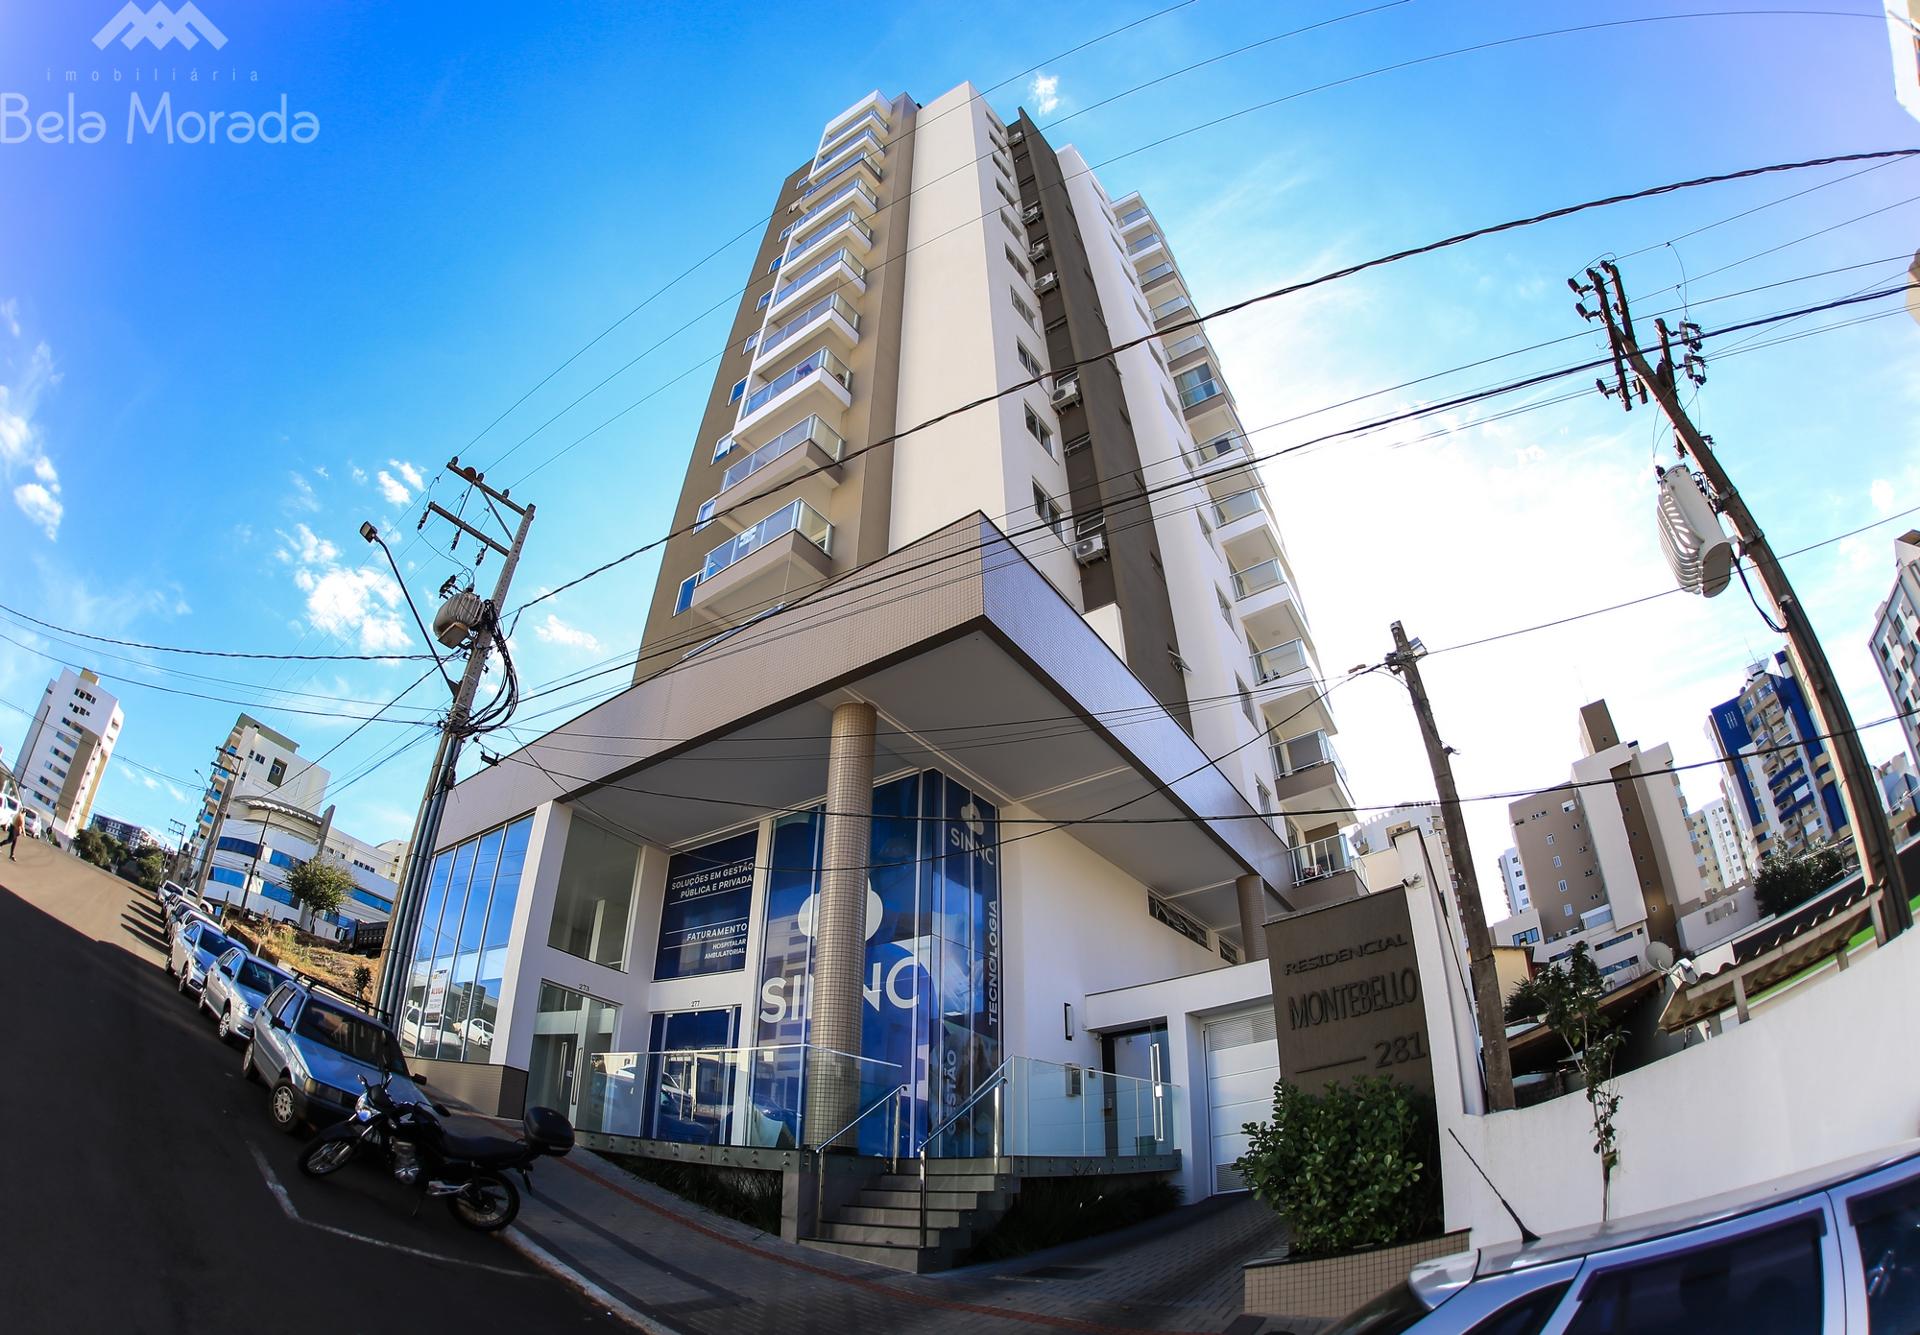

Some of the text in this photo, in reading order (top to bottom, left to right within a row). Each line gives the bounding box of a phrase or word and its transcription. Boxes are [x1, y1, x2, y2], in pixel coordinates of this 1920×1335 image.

[950, 827, 994, 865] SINNC
[671, 862, 754, 890] SOLUÇÕES EM GESTÃO
[680, 874, 753, 899] PÚBLICA E PRIVADA
[686, 923, 747, 941] FATURAMENTO
[712, 938, 746, 949] HOSPITALAR
[704, 947, 745, 960] AMBULATORIAL
[988, 899, 998, 1026] TECNOLOGIA
[1284, 934, 1408, 976] RESIDENCIAL
[1288, 967, 1418, 1031] MONTEBELLO
[1375, 1032, 1426, 1069] 281
